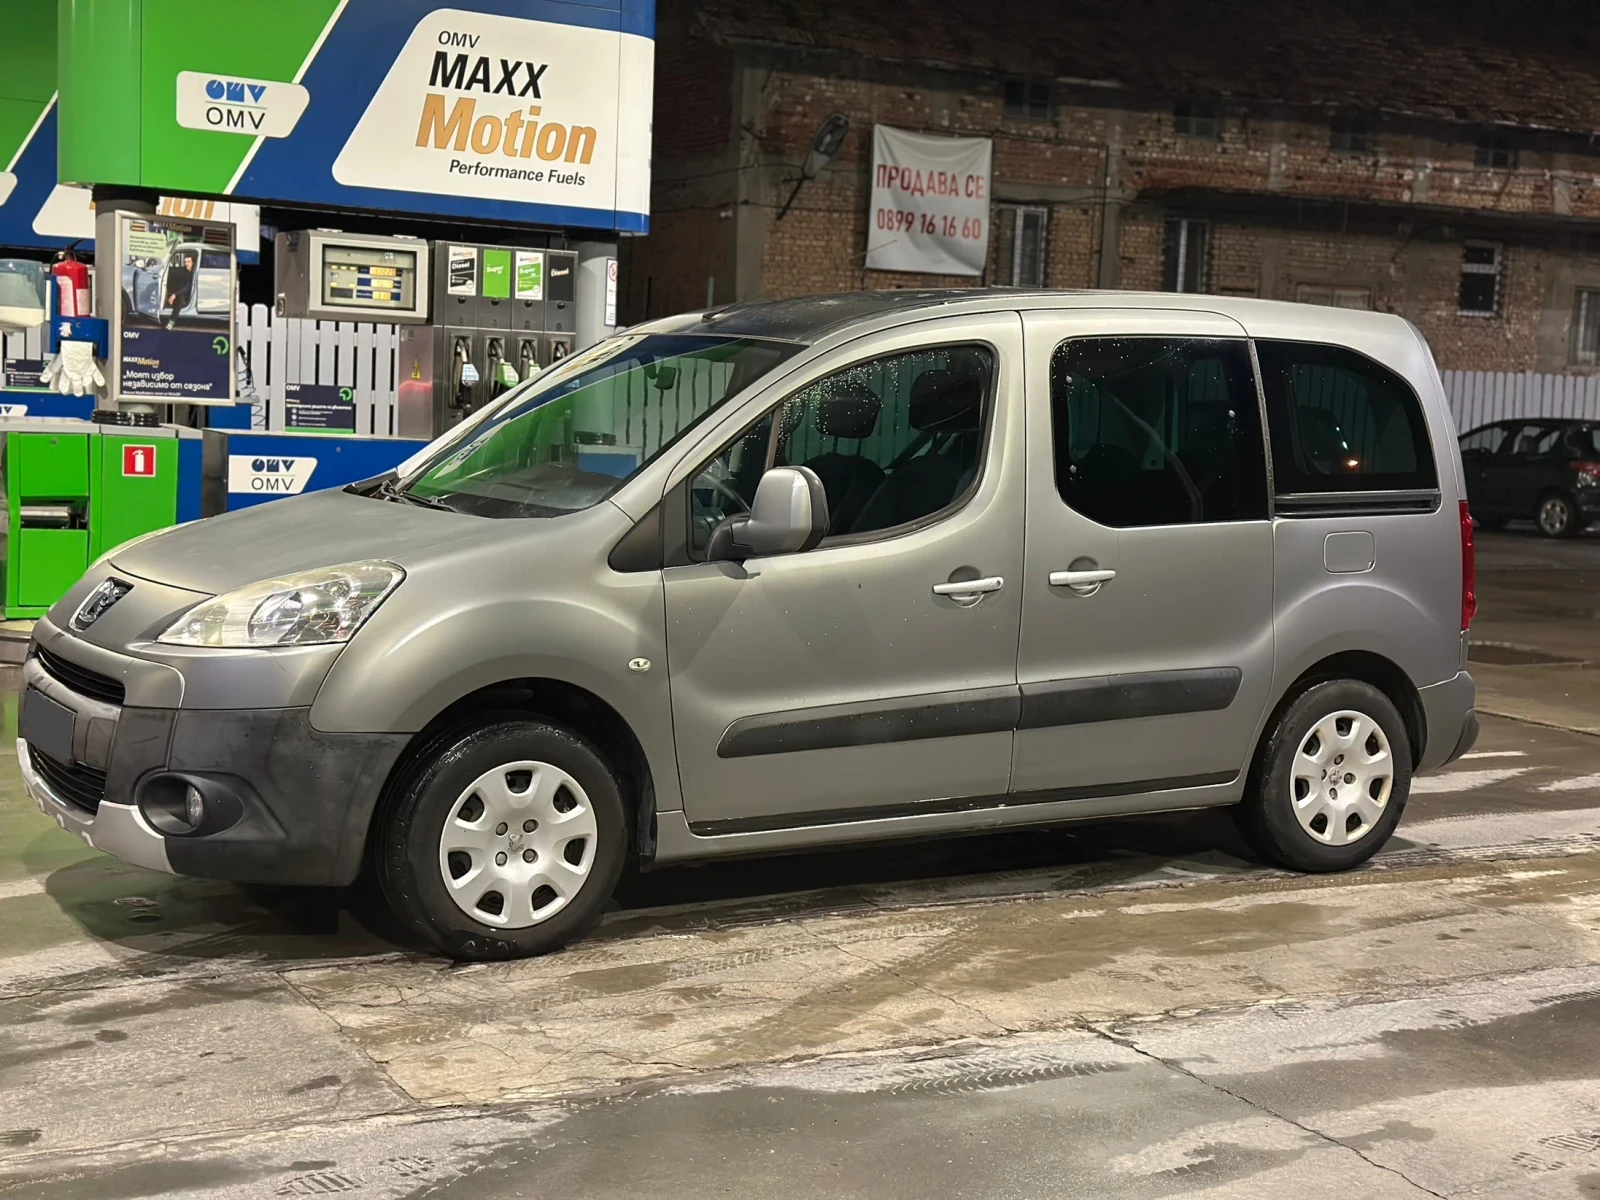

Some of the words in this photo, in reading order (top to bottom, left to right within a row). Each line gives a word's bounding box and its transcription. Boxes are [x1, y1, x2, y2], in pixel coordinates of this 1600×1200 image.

[438, 30, 481, 49] OMV
[428, 50, 549, 99] MAXX
[205, 106, 266, 130] OMV
[415, 93, 597, 165] Motion
[449, 159, 544, 182] Performance
[547, 169, 586, 186] Fuels
[876, 164, 959, 197] ПРОДАВА
[965, 174, 985, 199] СЕ
[877, 208, 915, 233] 0899
[921, 213, 936, 235] 16
[942, 215, 957, 238] 16
[962, 217, 982, 240] 60
[123, 331, 140, 339] OMV
[122, 380, 169, 389] независимо
[151, 371, 175, 381] избор
[251, 477, 295, 491] OMV
